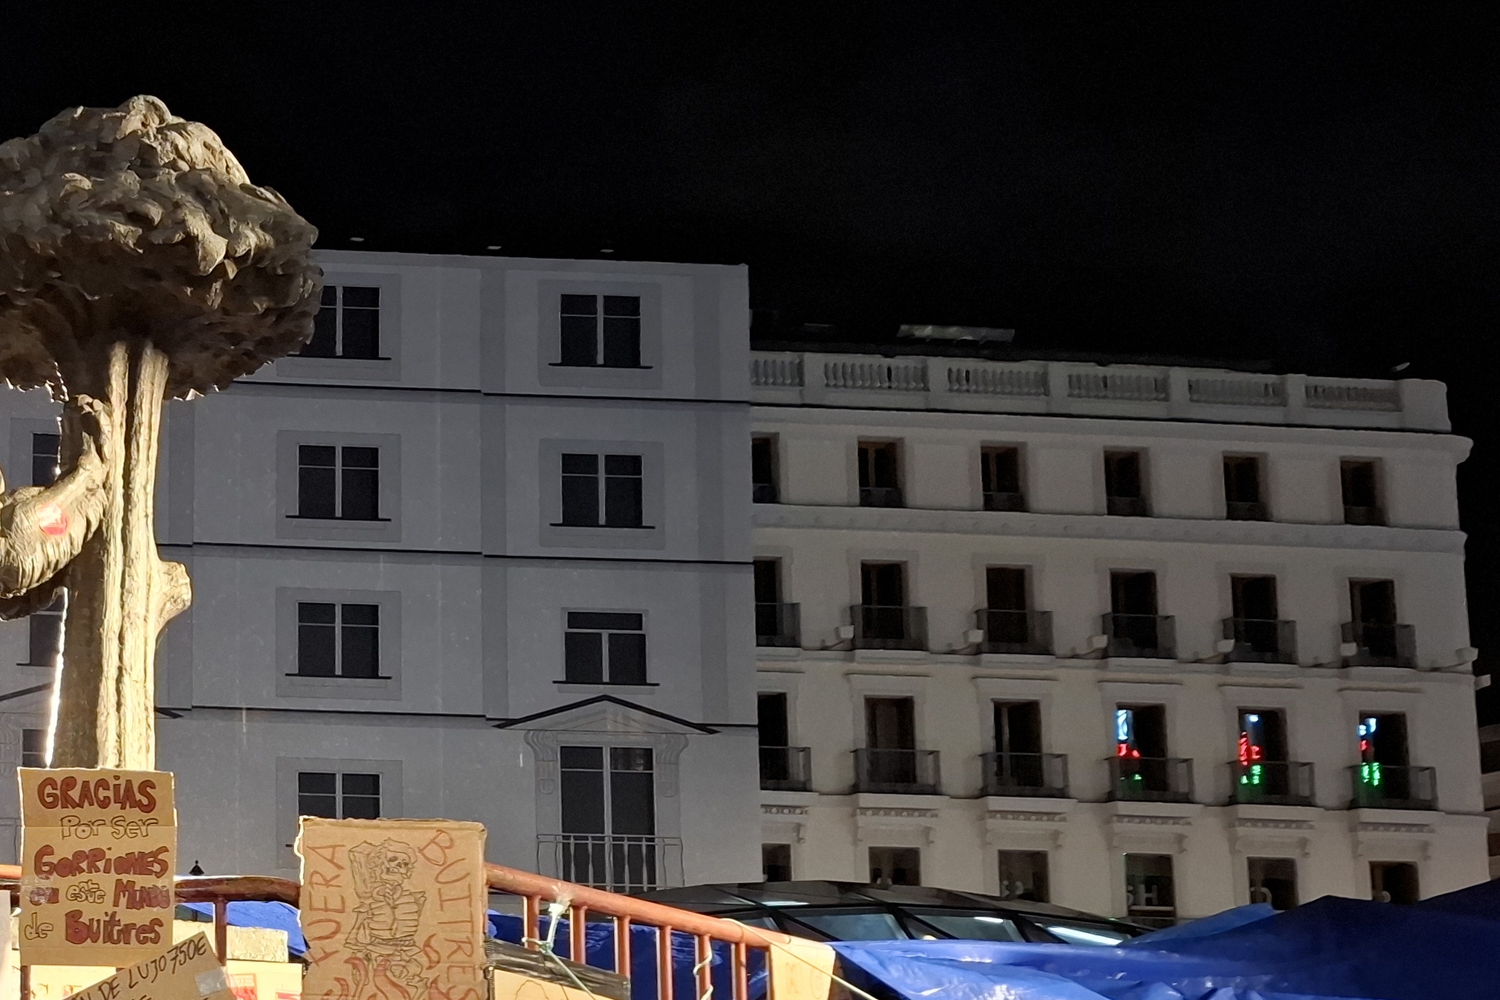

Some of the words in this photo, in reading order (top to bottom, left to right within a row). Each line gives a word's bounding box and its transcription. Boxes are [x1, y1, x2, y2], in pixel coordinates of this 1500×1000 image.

[306, 843, 348, 968] FUERA
[128, 953, 168, 988] LUJO
[168, 936, 208, 975] 750€
